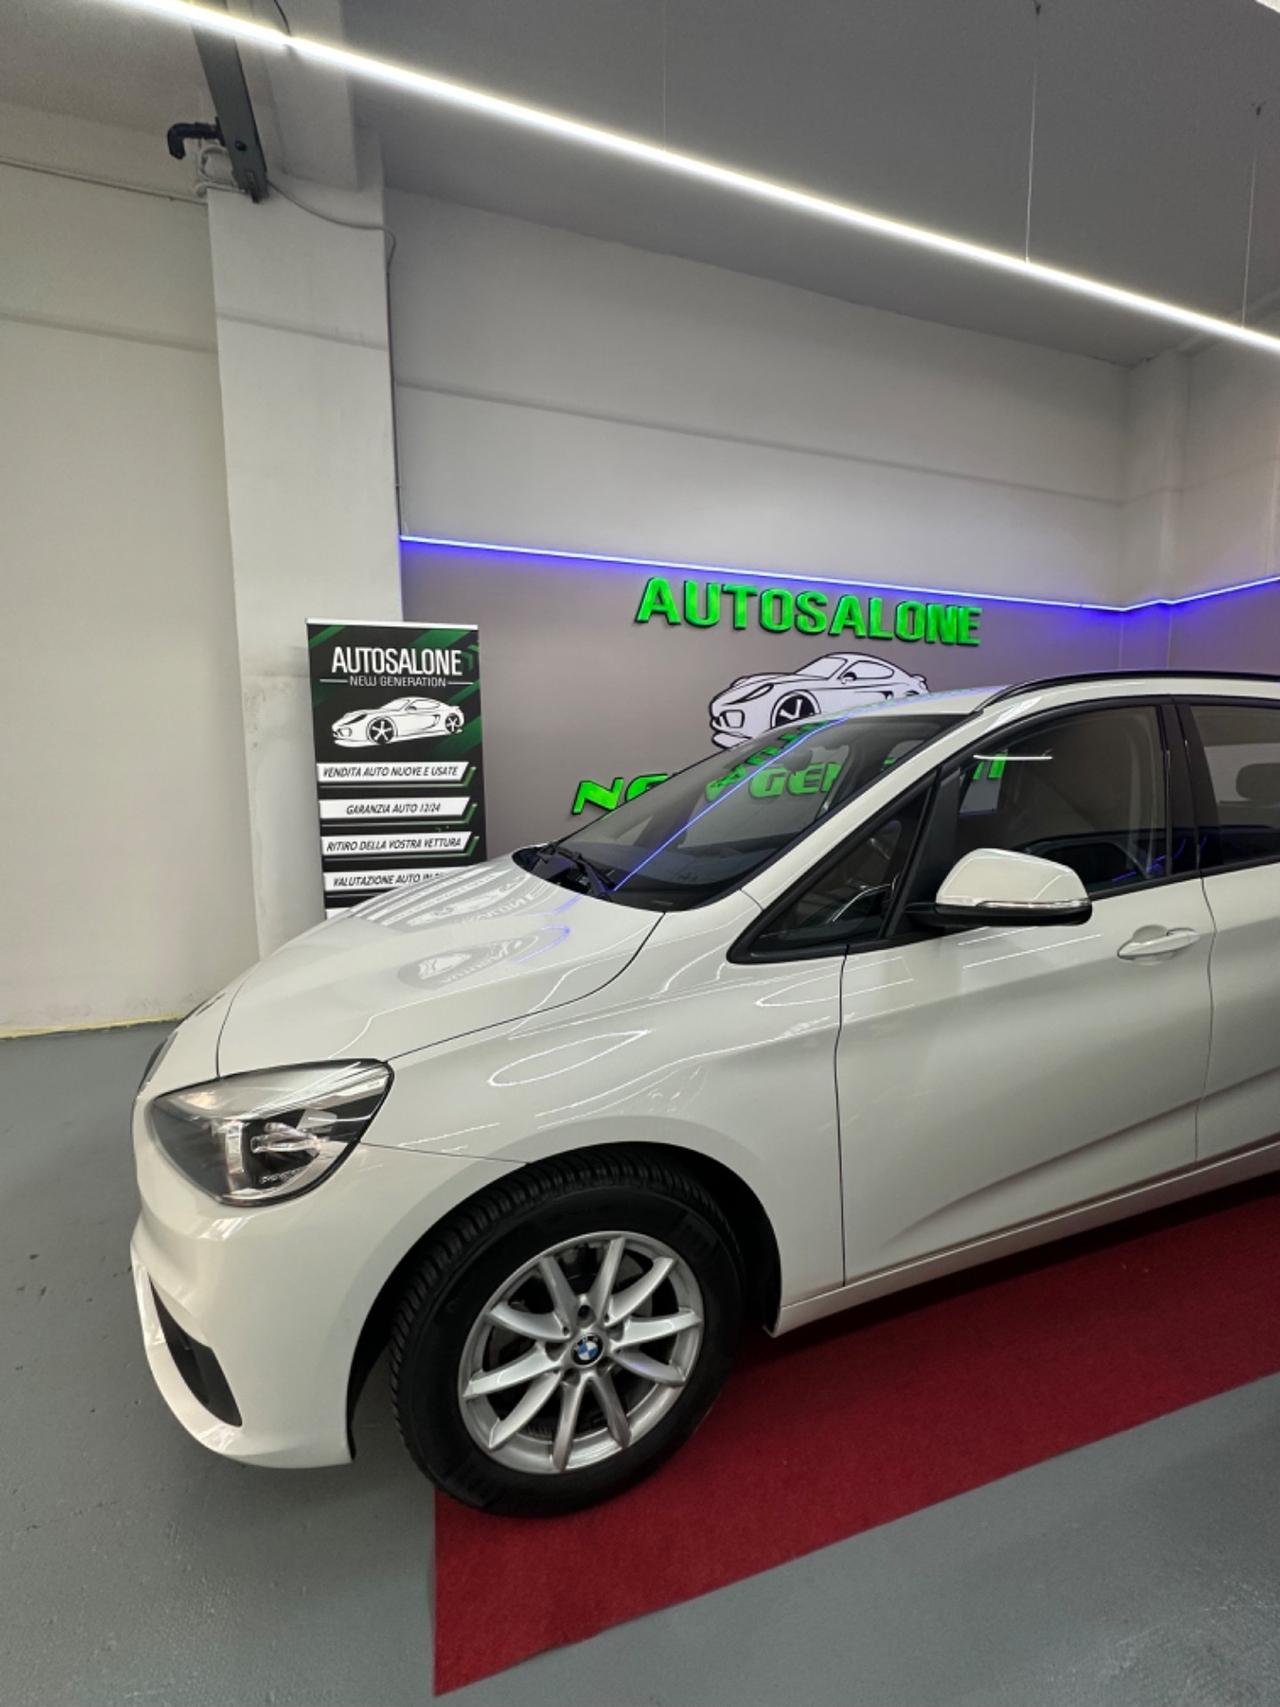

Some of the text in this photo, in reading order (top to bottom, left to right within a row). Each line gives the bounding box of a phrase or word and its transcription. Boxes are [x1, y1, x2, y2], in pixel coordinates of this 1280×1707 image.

[635, 576, 983, 646] AUTOSALONE
[331, 646, 463, 676] AUTOSALONE
[350, 675, 447, 688] NEW GENERATION
[323, 765, 458, 778] VENDITA AUTO NUOVE E USATE
[346, 803, 441, 815] GARANZIA AUTO 12/24
[326, 837, 461, 852] RITIRO DELLA VOSTRA VETTURA
[333, 874, 394, 887] VALUTAZIONE
[395, 873, 420, 884] AUTO
